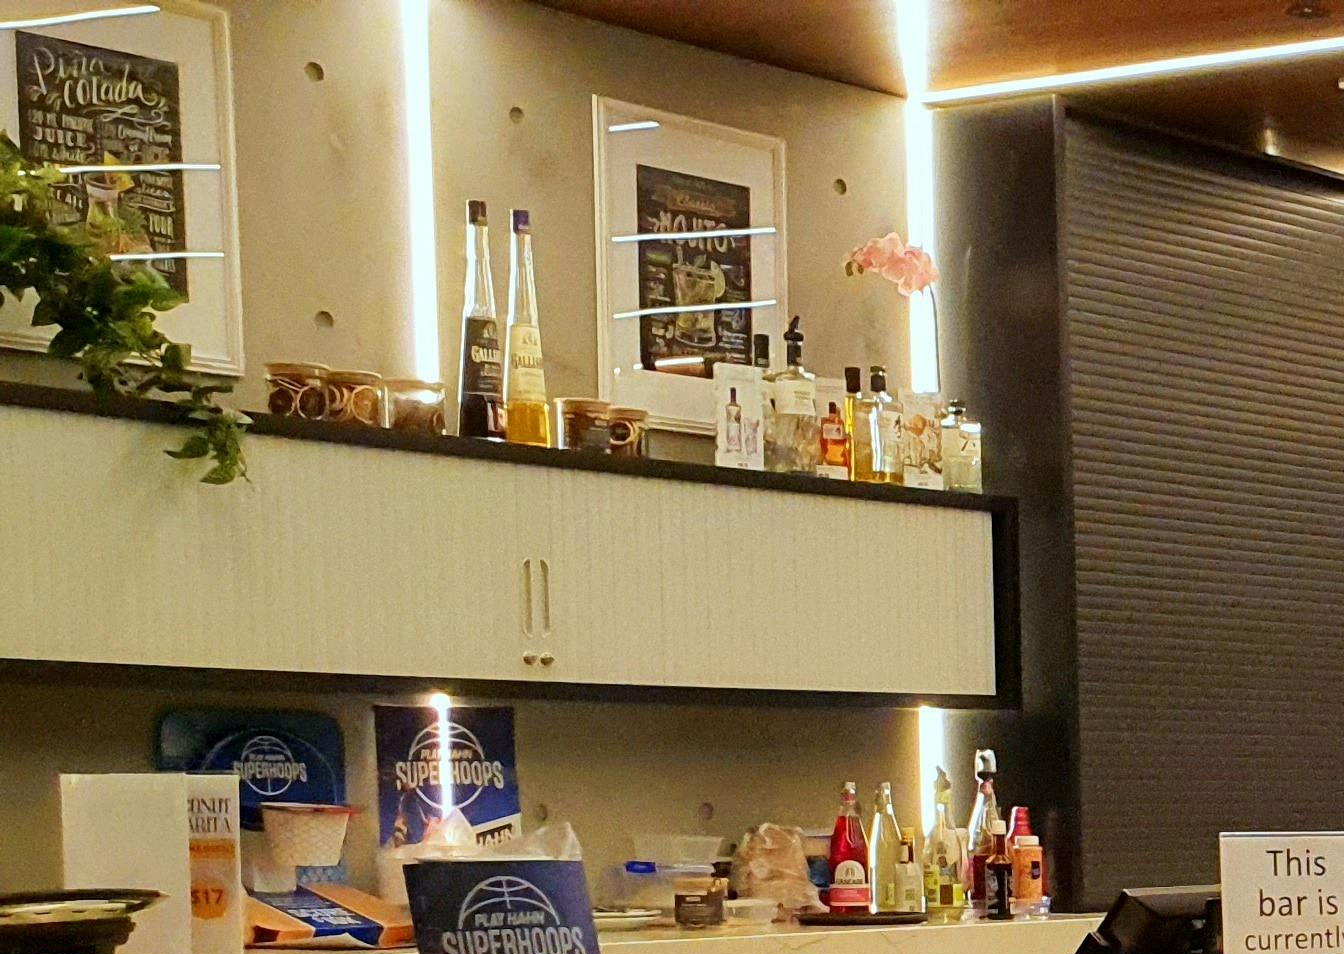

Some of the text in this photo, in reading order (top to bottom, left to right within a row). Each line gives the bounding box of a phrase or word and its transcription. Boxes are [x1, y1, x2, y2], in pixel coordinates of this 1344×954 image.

[234, 761, 307, 783] SUPERHOOPS
[395, 761, 505, 790] SUPEHOOPS
[1266, 848, 1326, 876] This
[1259, 888, 1339, 917] bar is
[475, 910, 545, 927] PLAY HAHN
